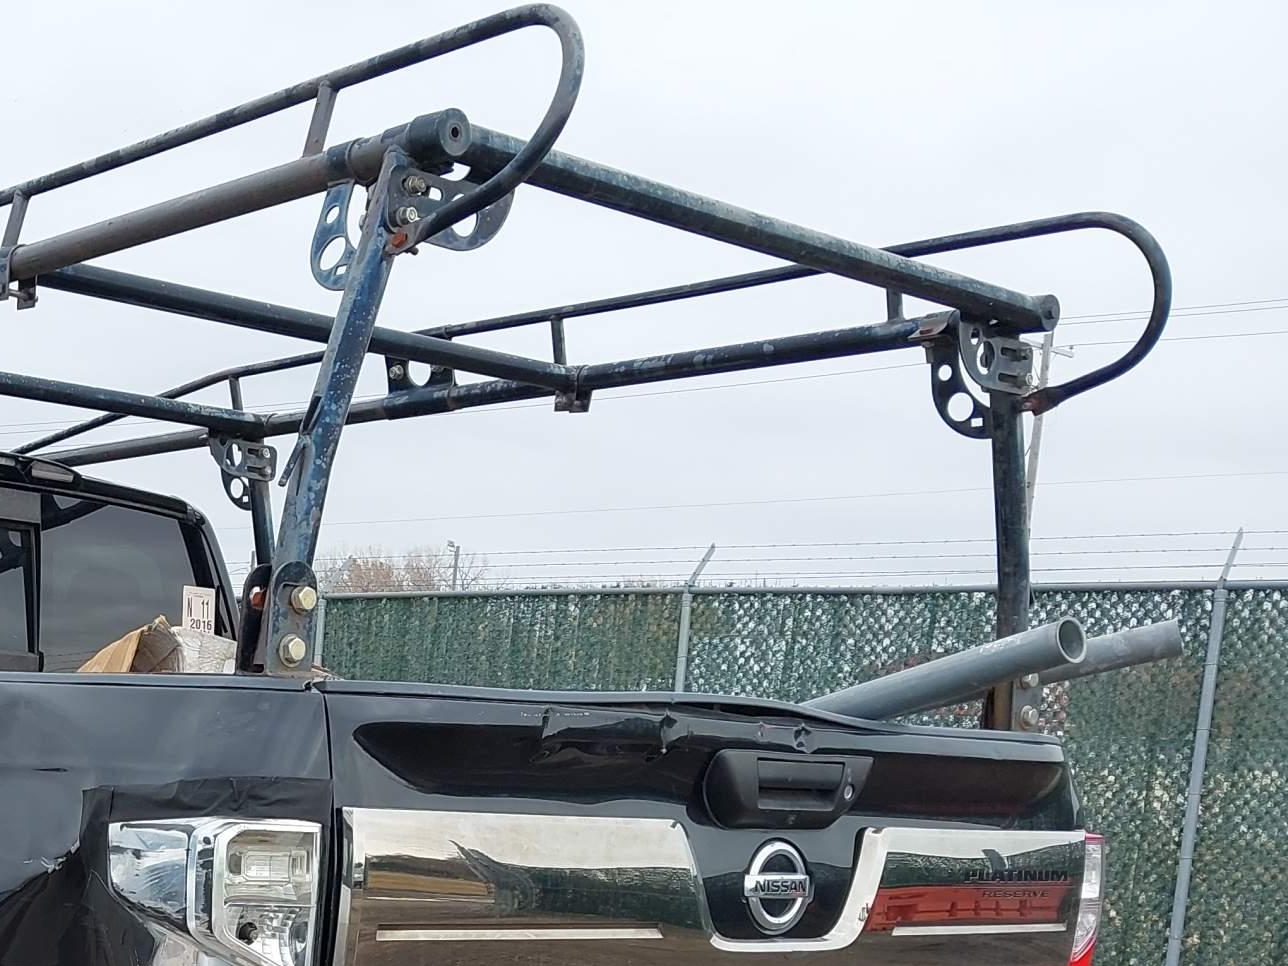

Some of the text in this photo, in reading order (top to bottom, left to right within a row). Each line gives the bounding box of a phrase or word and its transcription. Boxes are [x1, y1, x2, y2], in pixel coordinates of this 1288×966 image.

[190, 618, 213, 631] 2016
[965, 869, 1068, 883] PLATINUM
[754, 880, 806, 893] NISSAN
[982, 889, 1050, 898] RESERVE
